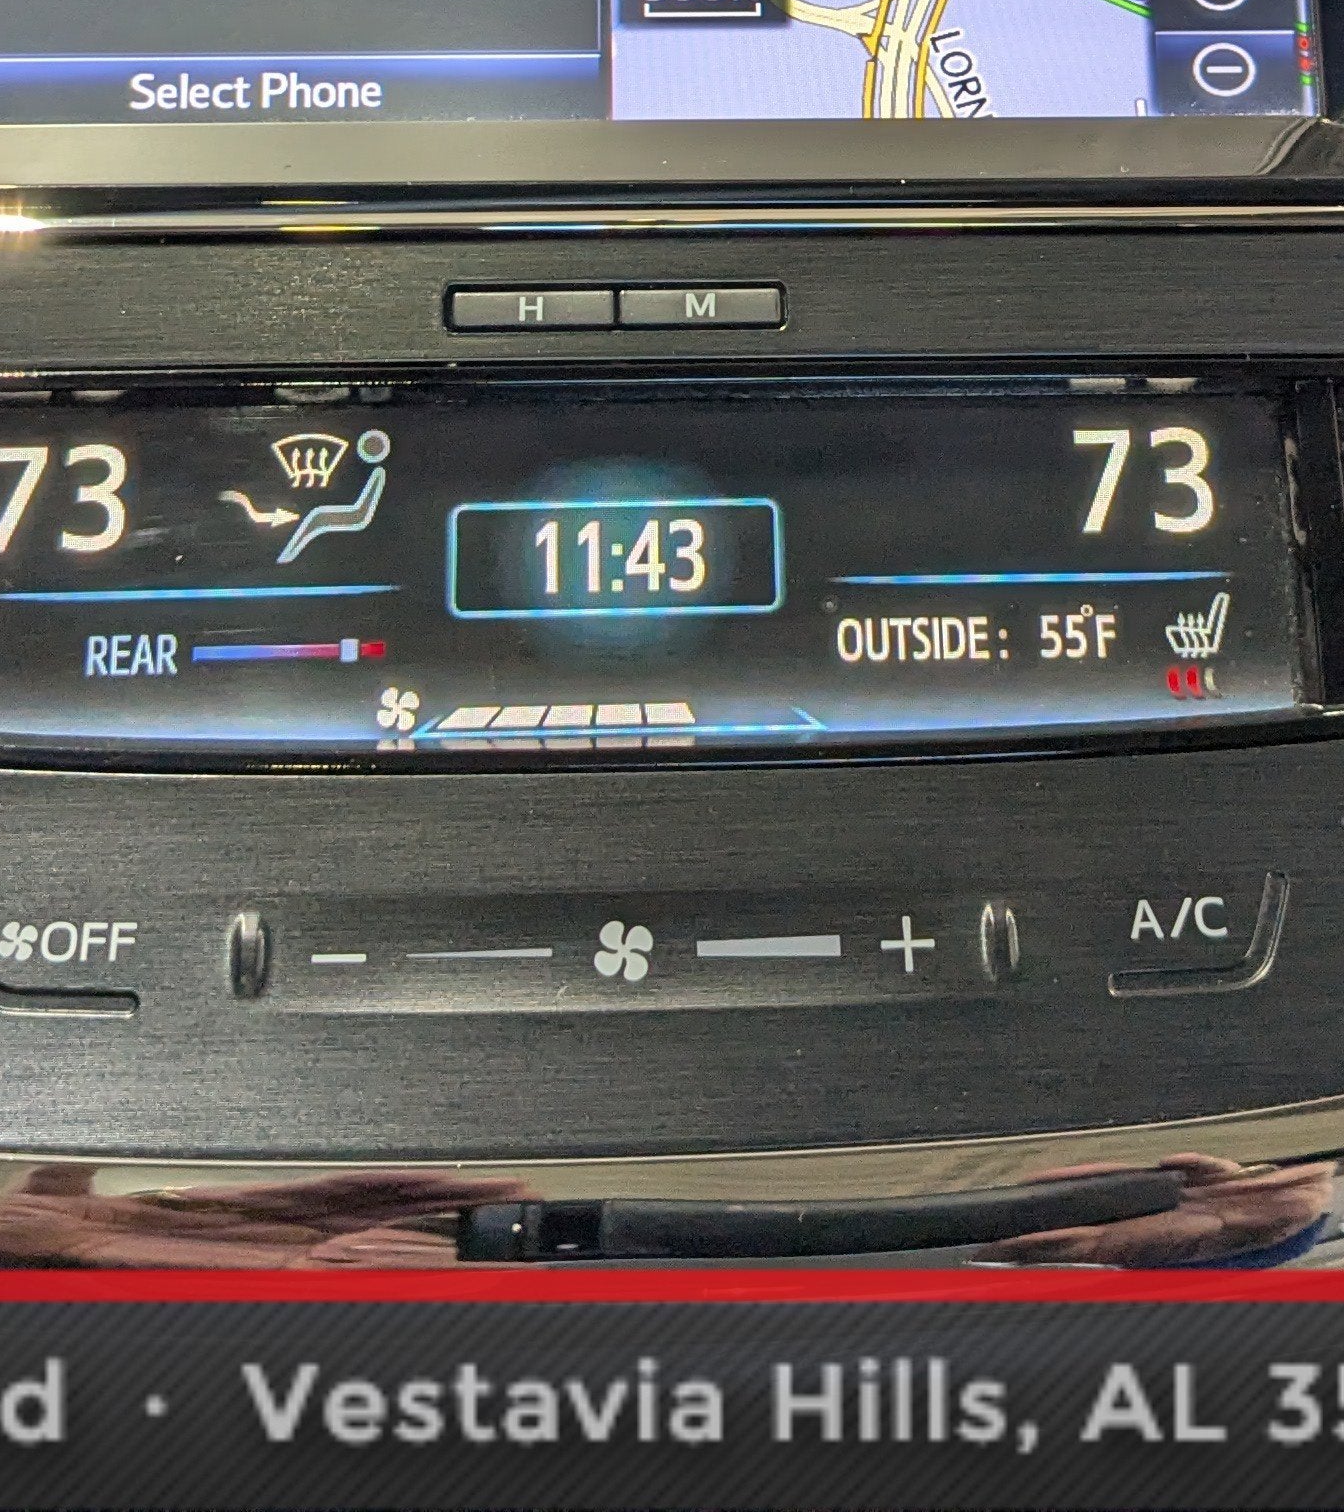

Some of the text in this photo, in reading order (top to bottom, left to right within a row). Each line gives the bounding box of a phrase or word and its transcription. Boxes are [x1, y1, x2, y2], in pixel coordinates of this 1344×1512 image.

[130, 72, 383, 110] Select Phone
[518, 296, 544, 322] H
[686, 292, 716, 319] M
[1072, 426, 1216, 534] 73
[532, 517, 707, 595] 11:43
[84, 636, 179, 677] REAR
[1129, 895, 1229, 941] A/C
[38, 921, 138, 963] OFF
